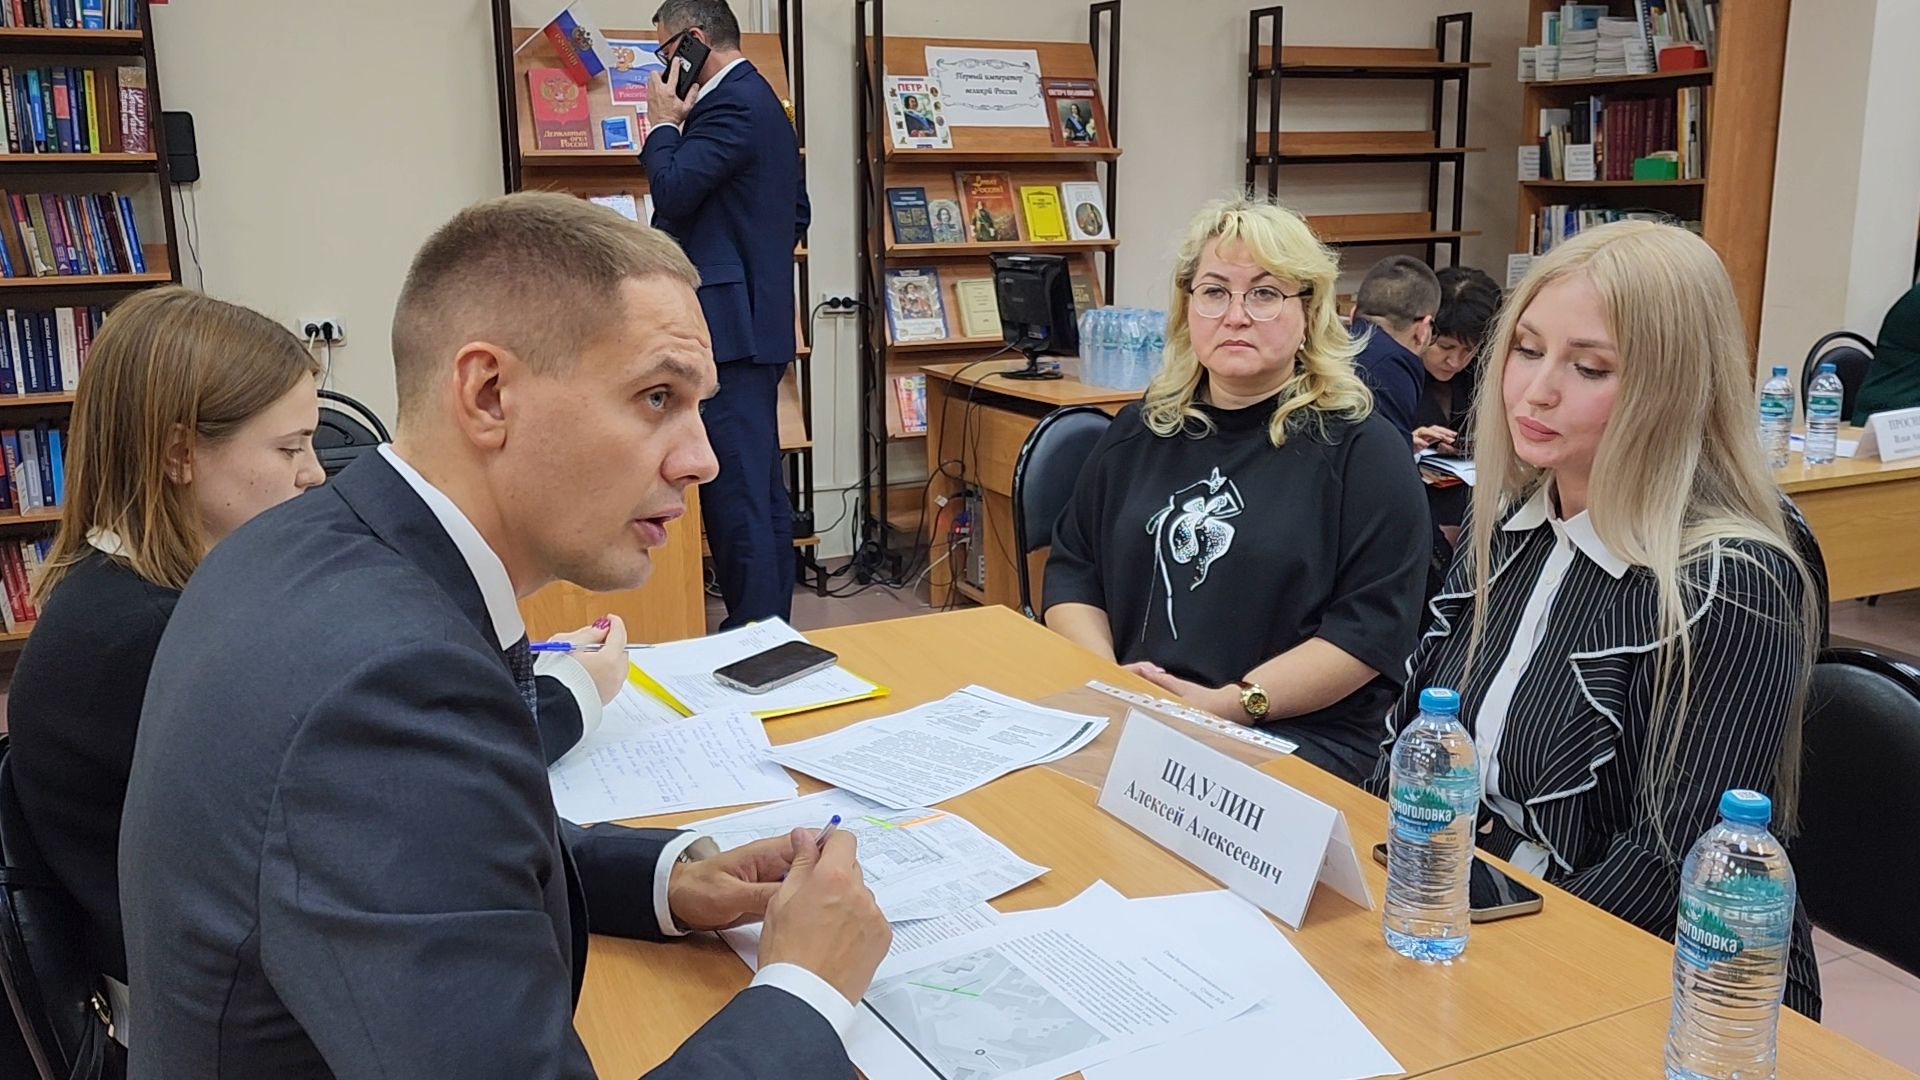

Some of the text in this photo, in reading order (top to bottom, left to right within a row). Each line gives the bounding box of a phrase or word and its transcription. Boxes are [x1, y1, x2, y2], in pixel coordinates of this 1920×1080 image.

[955, 71, 1023, 83] Первый император
[897, 83, 922, 92] ПЕТР
[994, 87, 1018, 95] России
[1161, 758, 1266, 832] ЩАУЛИН
[1124, 779, 1283, 885] Алексей Алексеевич
